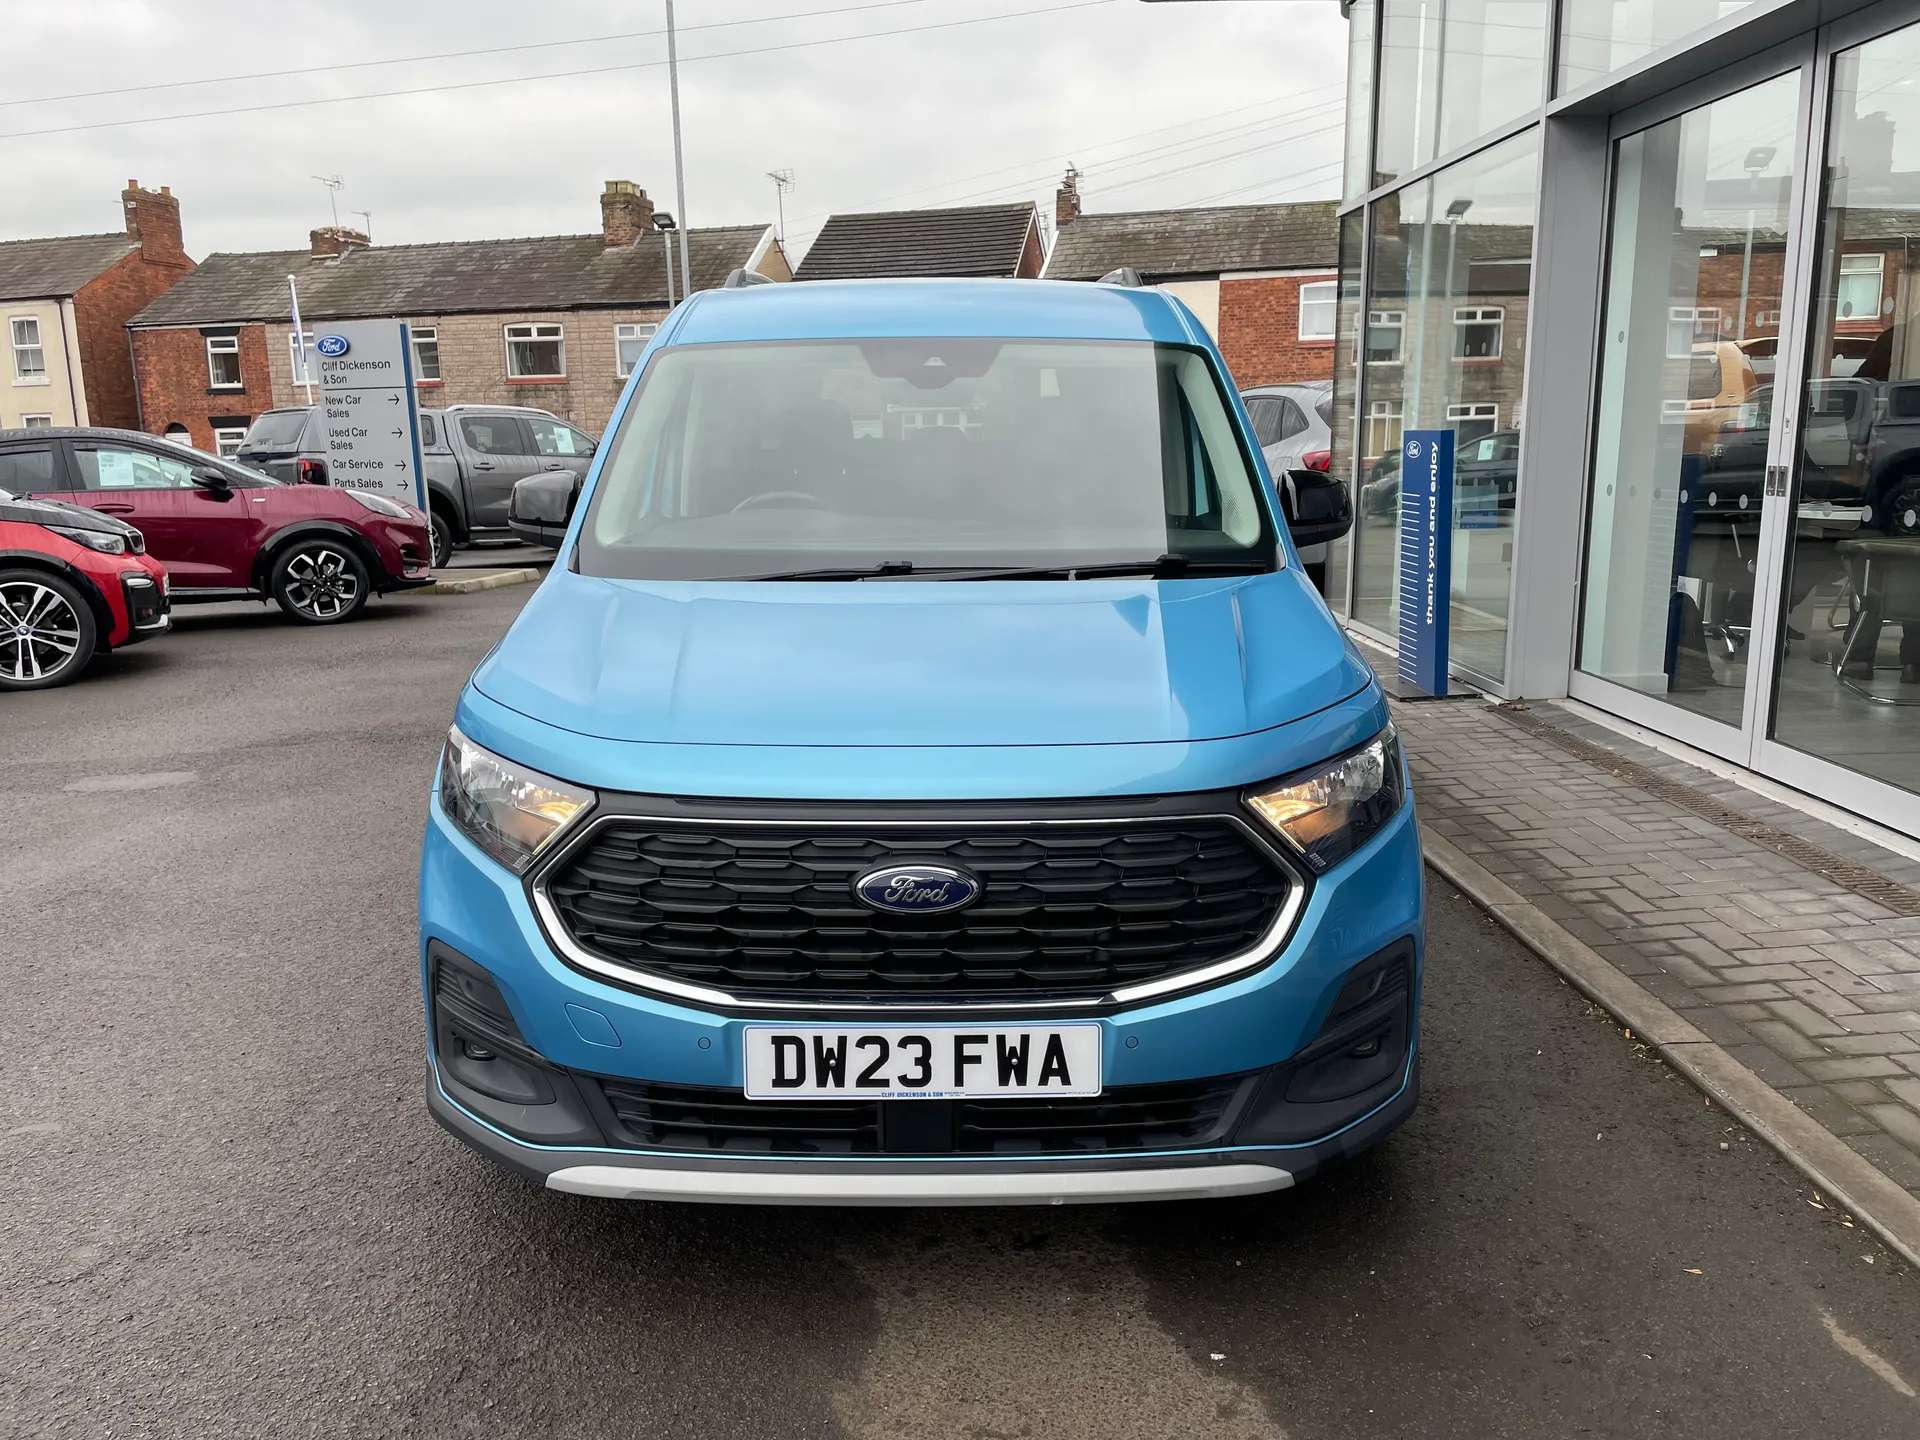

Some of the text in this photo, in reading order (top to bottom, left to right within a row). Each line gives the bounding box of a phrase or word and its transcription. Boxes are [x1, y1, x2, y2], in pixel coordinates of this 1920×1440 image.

[322, 338, 341, 352] Ford
[321, 359, 391, 372] Cliff Dickenson
[323, 374, 347, 385] & Son
[325, 394, 361, 406] New Car
[327, 409, 350, 418] Sales
[329, 427, 368, 438] Used Car
[330, 441, 353, 450] Sales
[332, 459, 384, 469] Car Service
[334, 478, 384, 489] Parts Sales
[1426, 441, 1439, 625] thank you and enjoy
[884, 875, 951, 903] Ford
[770, 1033, 1073, 1089] DW23 FWA
